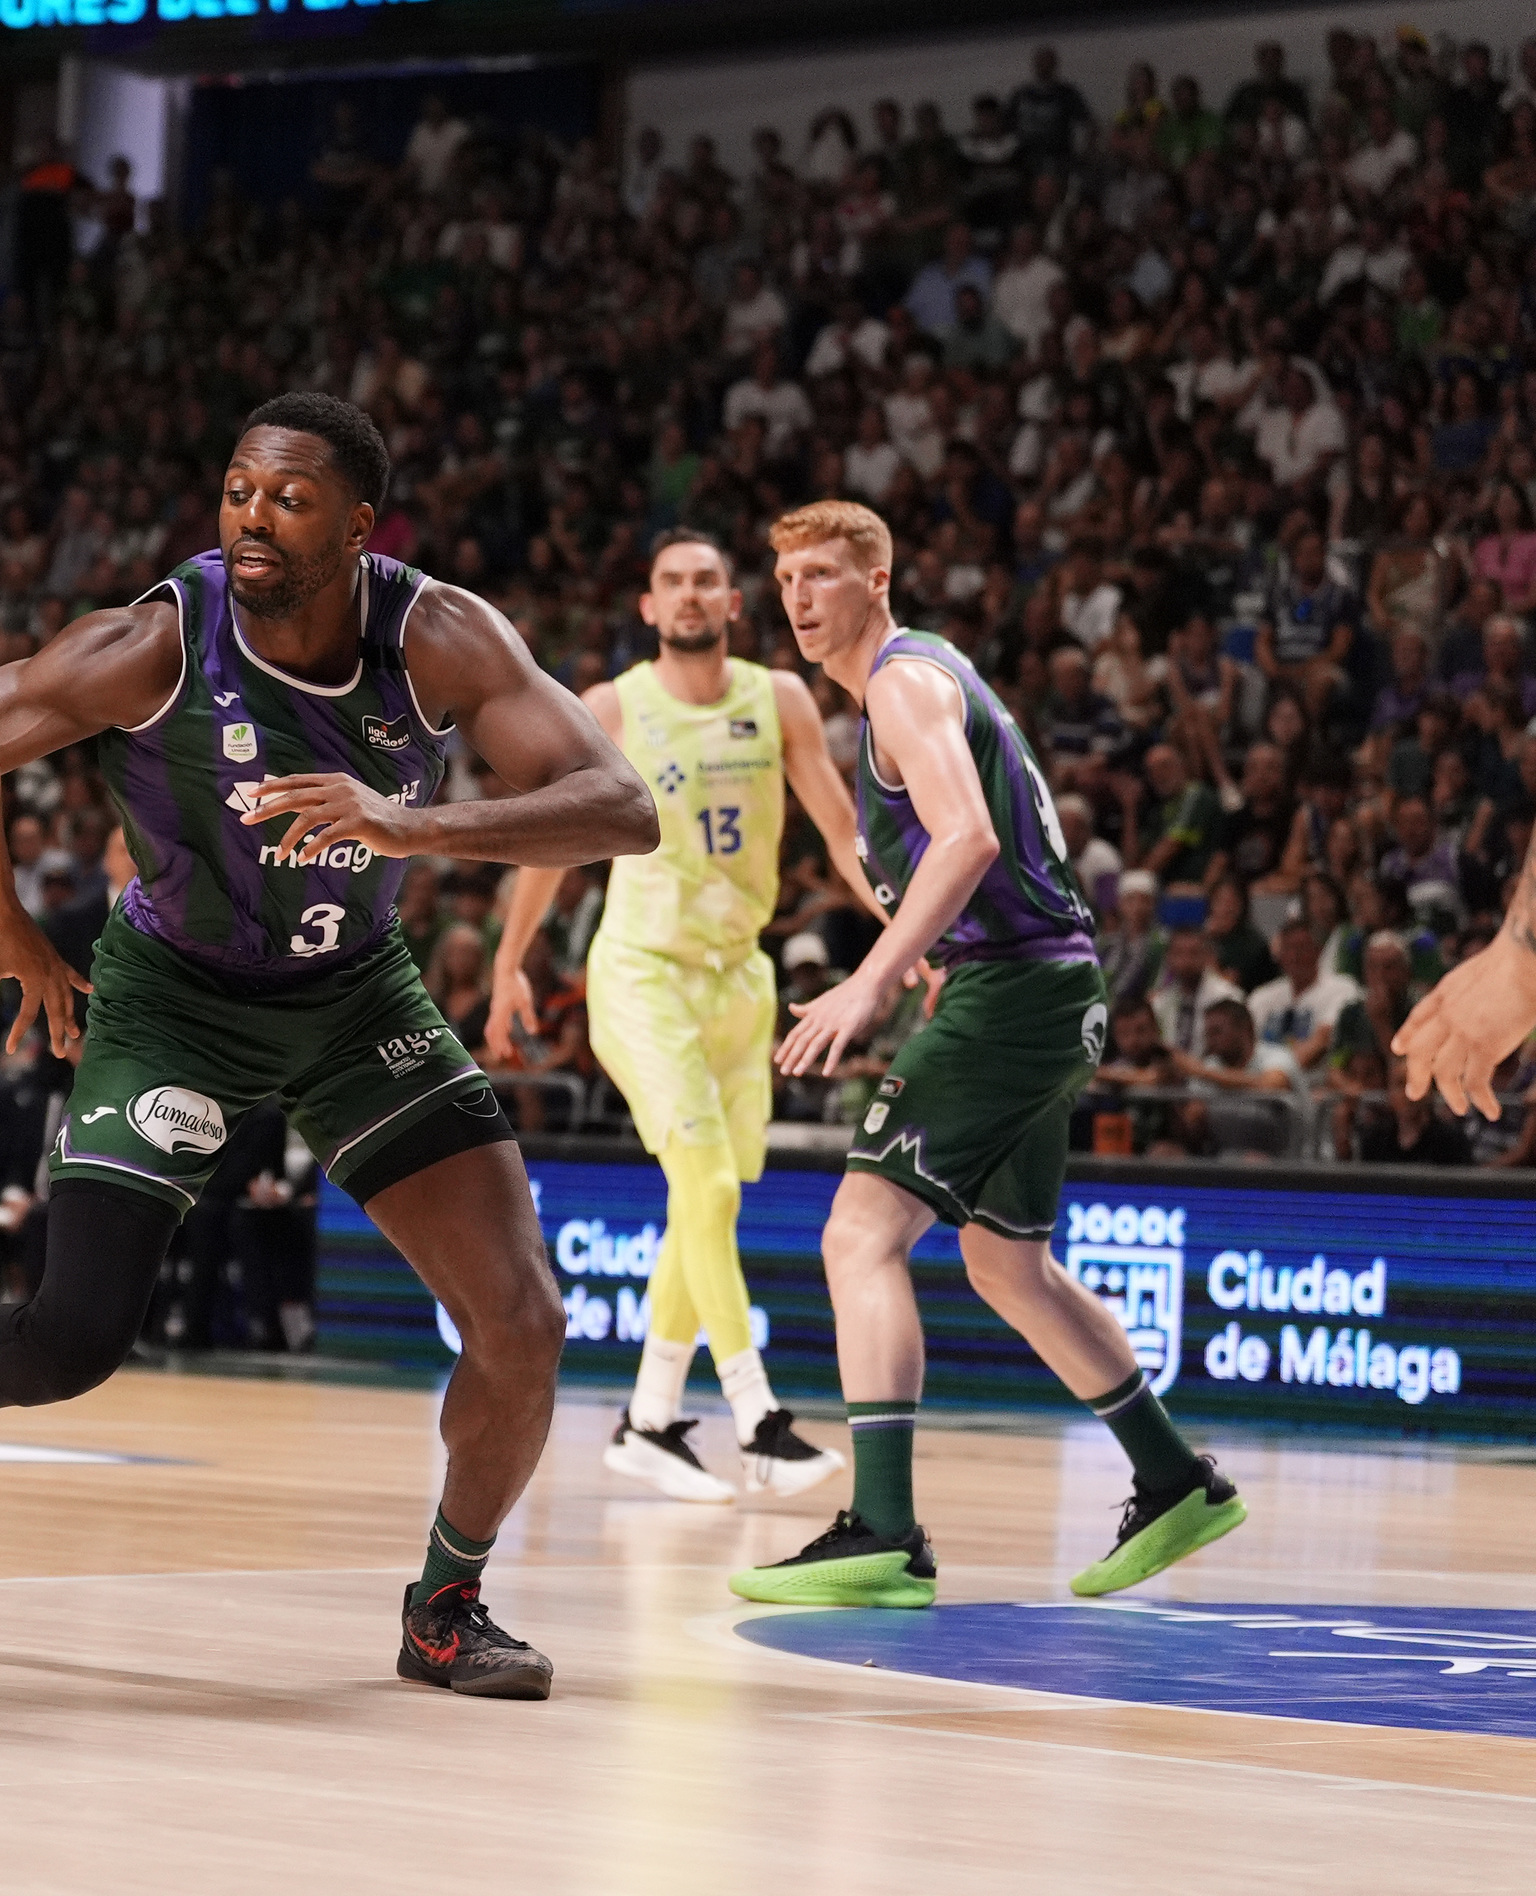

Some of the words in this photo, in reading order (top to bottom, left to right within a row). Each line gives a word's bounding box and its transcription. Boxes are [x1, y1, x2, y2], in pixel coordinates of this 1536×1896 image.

[367, 725, 388, 738] liga
[368, 733, 410, 747] endesa
[697, 806, 743, 856] 13
[289, 902, 346, 958] 3
[138, 1089, 223, 1142] famadesa
[556, 1218, 663, 1278] Ciud
[1207, 1249, 1387, 1317] Ciudad
[564, 1284, 612, 1341] de
[1204, 1321, 1270, 1381] de
[1279, 1324, 1462, 1404] Málaga
